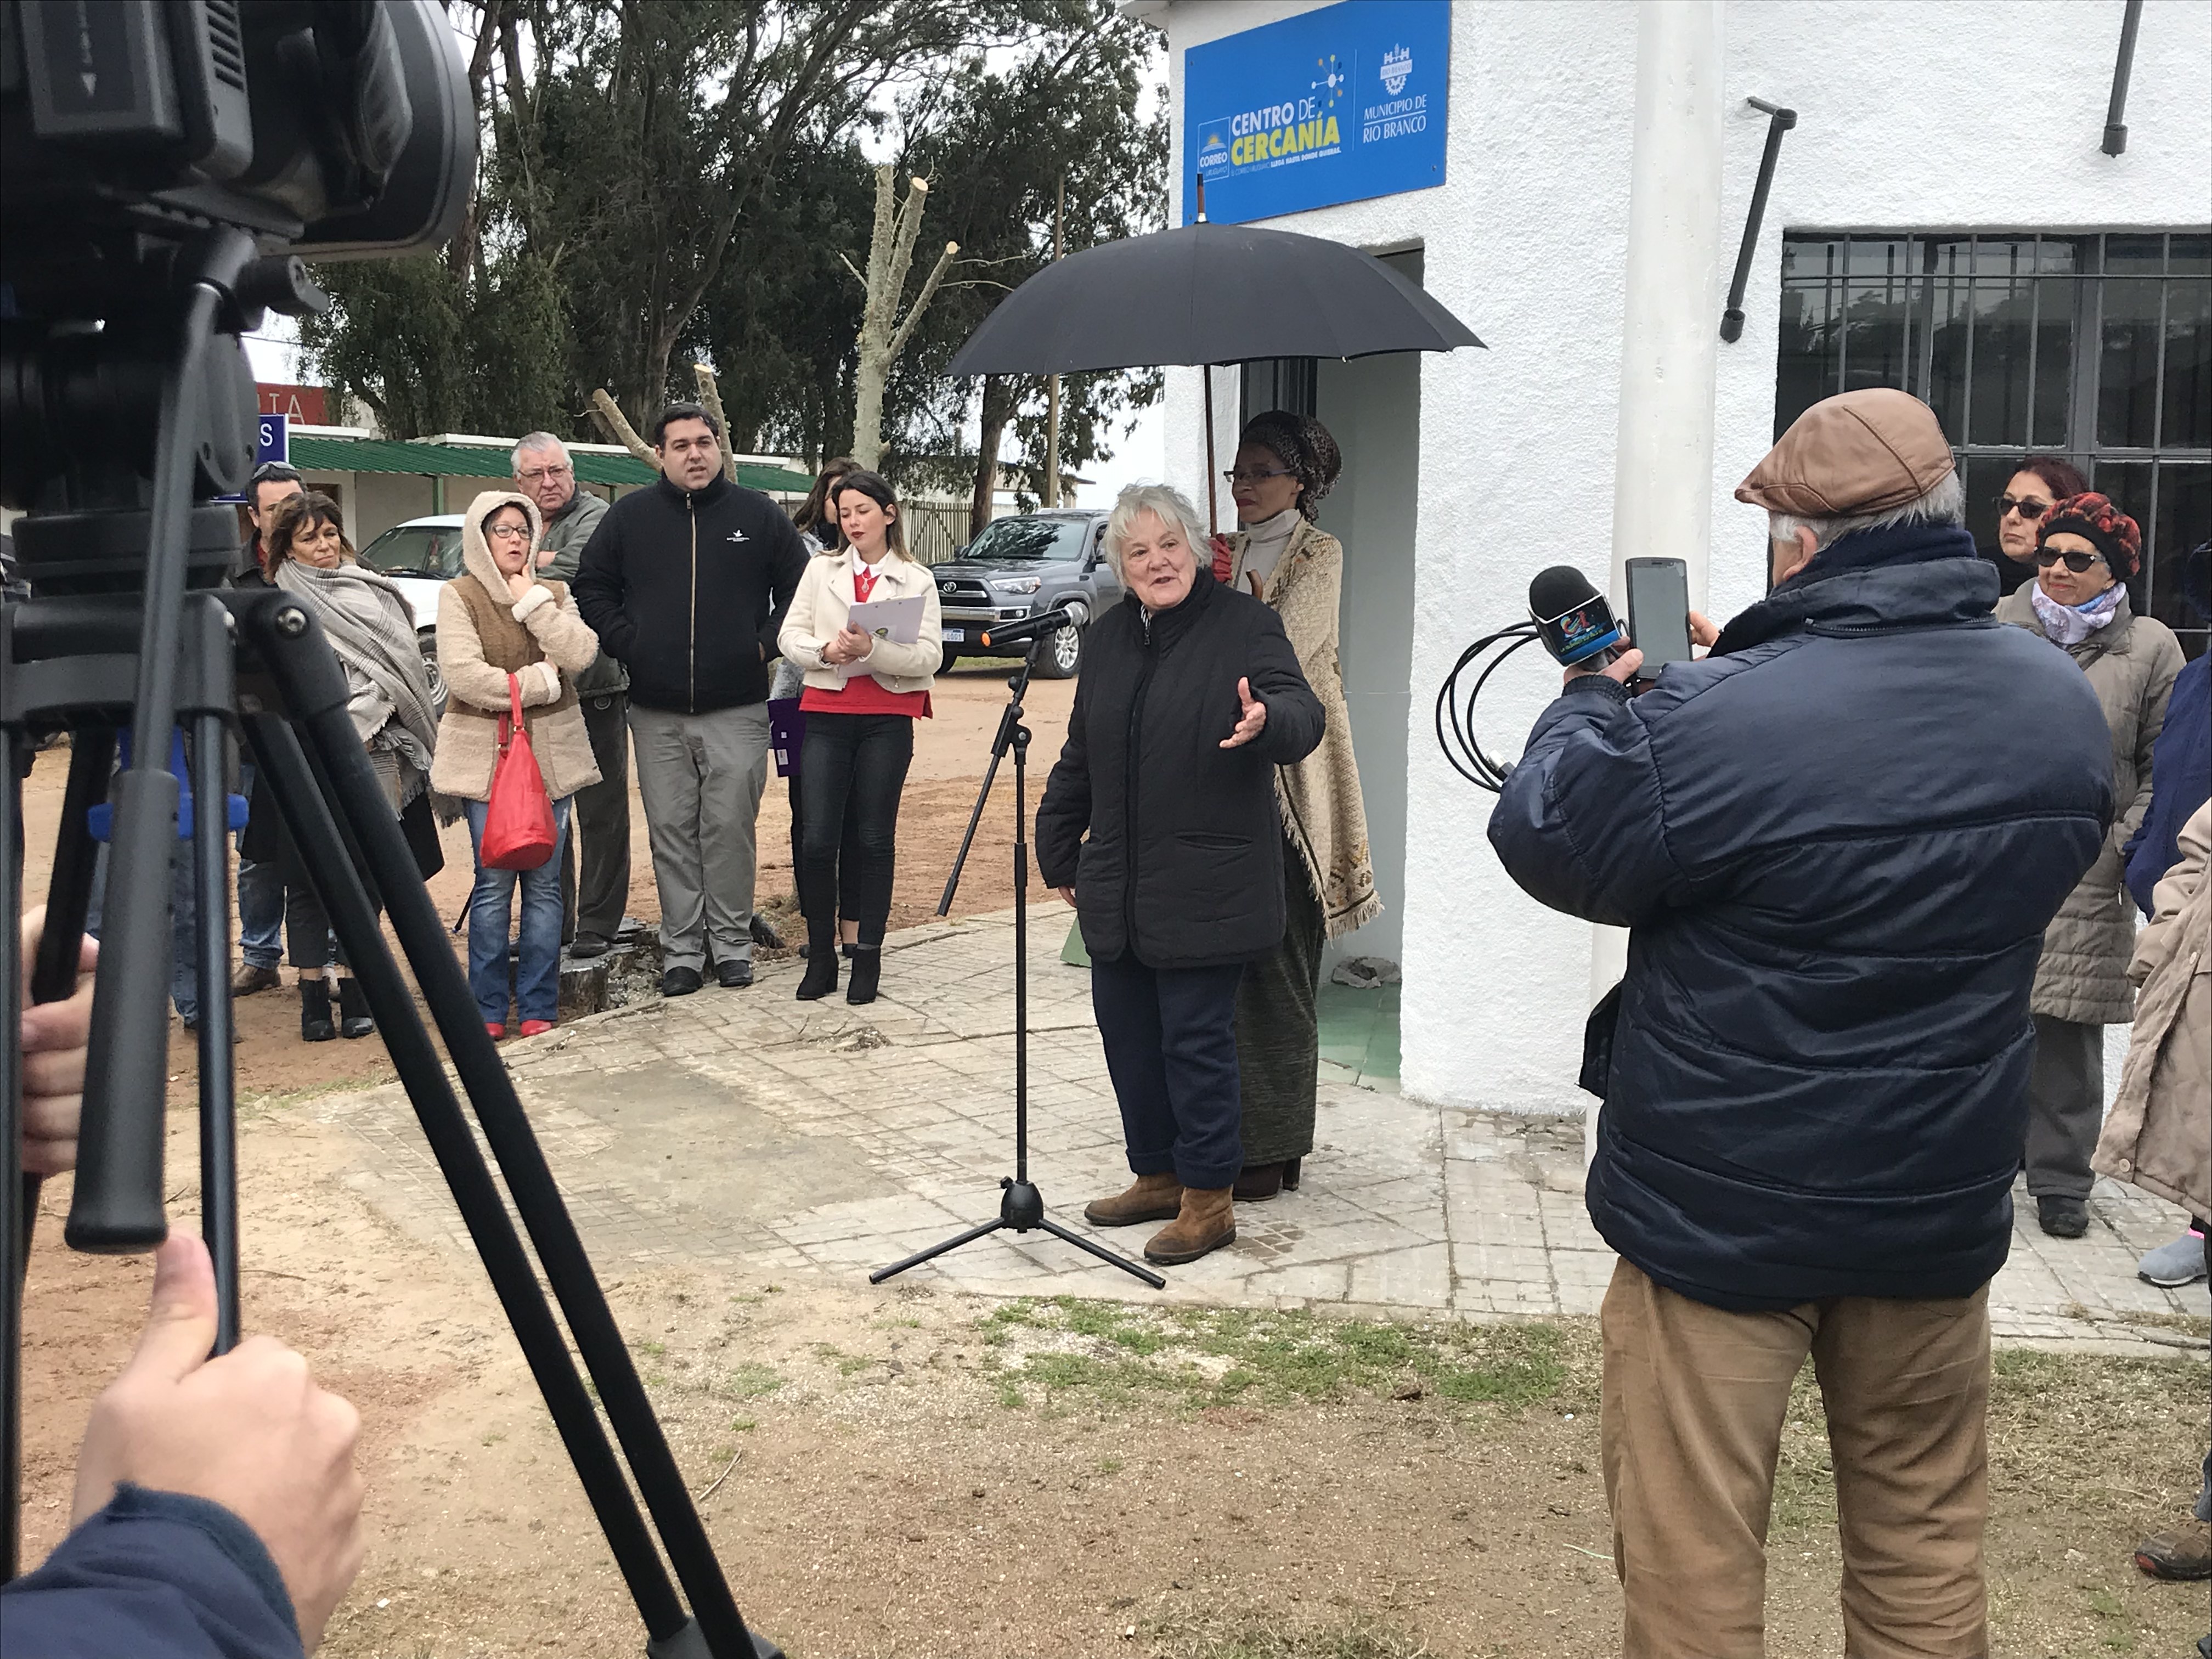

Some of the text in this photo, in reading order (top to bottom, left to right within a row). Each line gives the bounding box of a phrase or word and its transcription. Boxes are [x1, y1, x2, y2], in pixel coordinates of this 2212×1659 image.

[1232, 96, 1316, 137] CENTRO DE
[1364, 94, 1427, 120] MUNICIPIO DE
[1231, 111, 1340, 166] CERCANÍA
[1363, 115, 1426, 143] RIO BRANCO
[1199, 151, 1228, 167] CORREO
